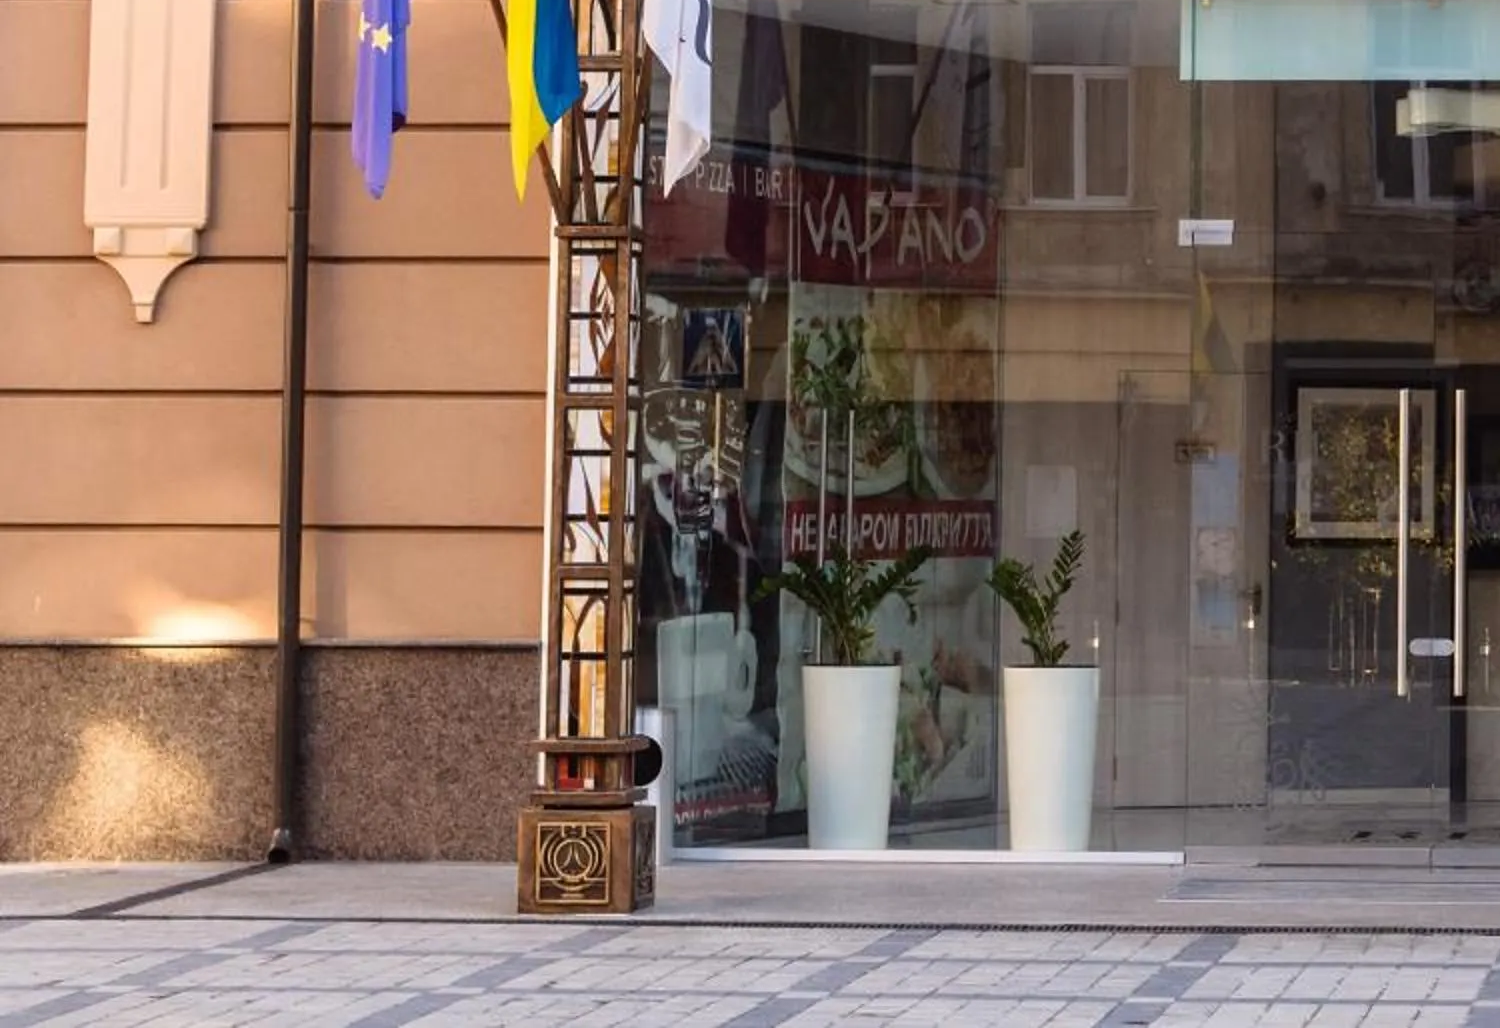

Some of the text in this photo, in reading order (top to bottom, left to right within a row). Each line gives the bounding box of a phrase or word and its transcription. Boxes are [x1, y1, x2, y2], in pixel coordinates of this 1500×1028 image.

[695, 161, 736, 193] PZZA
[803, 174, 987, 280] VAPANO
[790, 511, 899, 553] НЕААРОМ
